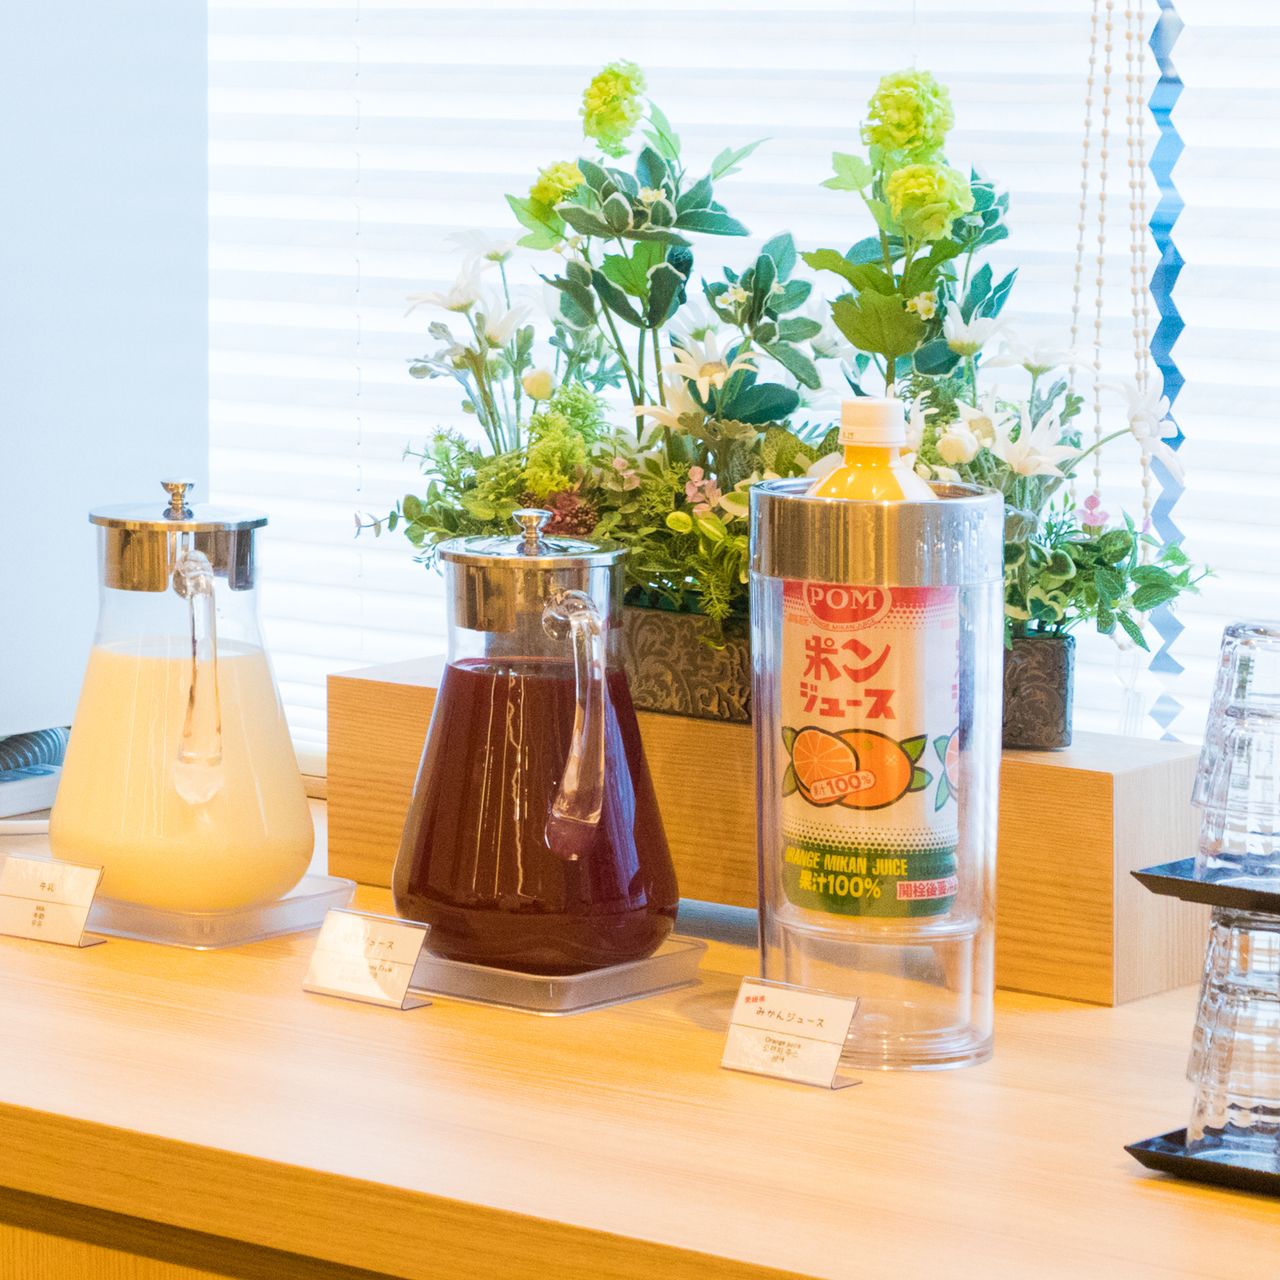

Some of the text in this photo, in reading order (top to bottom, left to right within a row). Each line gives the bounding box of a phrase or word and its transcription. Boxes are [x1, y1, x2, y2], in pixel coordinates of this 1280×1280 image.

[810, 587, 878, 610] POM
[804, 634, 891, 683] ポン
[800, 681, 897, 720] ジュース
[824, 854, 867, 875] MIKAN
[871, 858, 908, 876] JUICE
[800, 869, 881, 899] 果汁100%
[756, 1006, 824, 1028] みかんジュース
[765, 1036, 786, 1046] Orange
